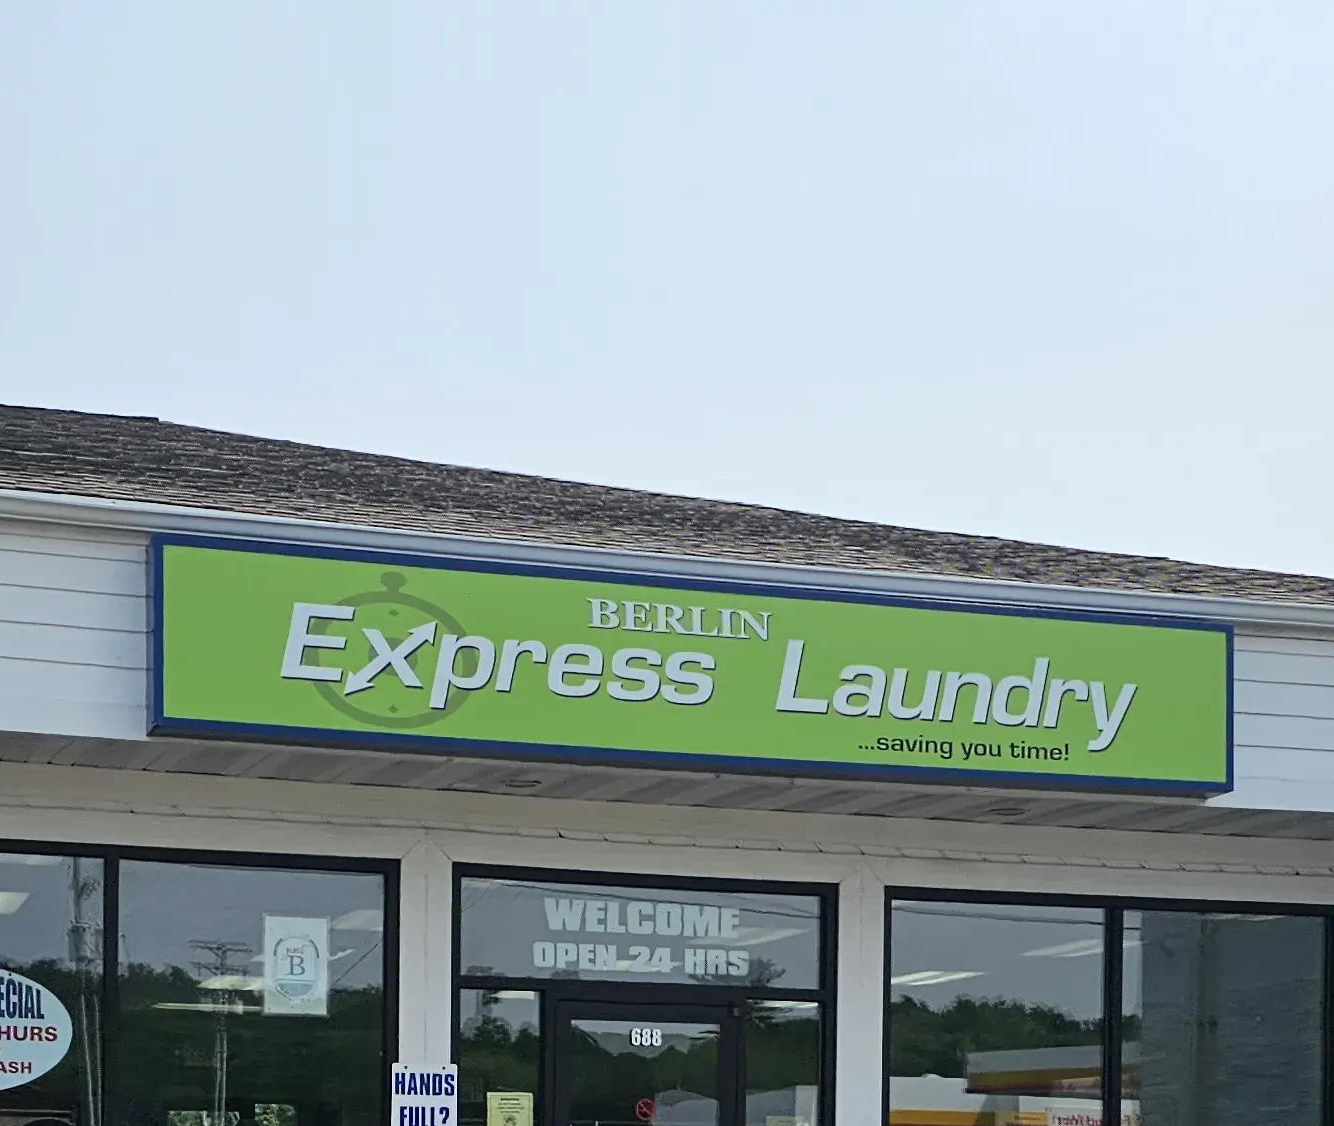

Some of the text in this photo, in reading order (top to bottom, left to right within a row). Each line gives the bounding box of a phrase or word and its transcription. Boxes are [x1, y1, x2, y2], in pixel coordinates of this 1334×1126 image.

[586, 597, 773, 640] BERLIN
[280, 602, 1138, 752] Express Laundry
[858, 735, 1070, 761] ...saving you time!
[544, 897, 740, 939] WELCOME
[532, 941, 750, 977] OPEN 24 HRS
[629, 1028, 663, 1047] 688
[394, 1072, 455, 1096] HANDS
